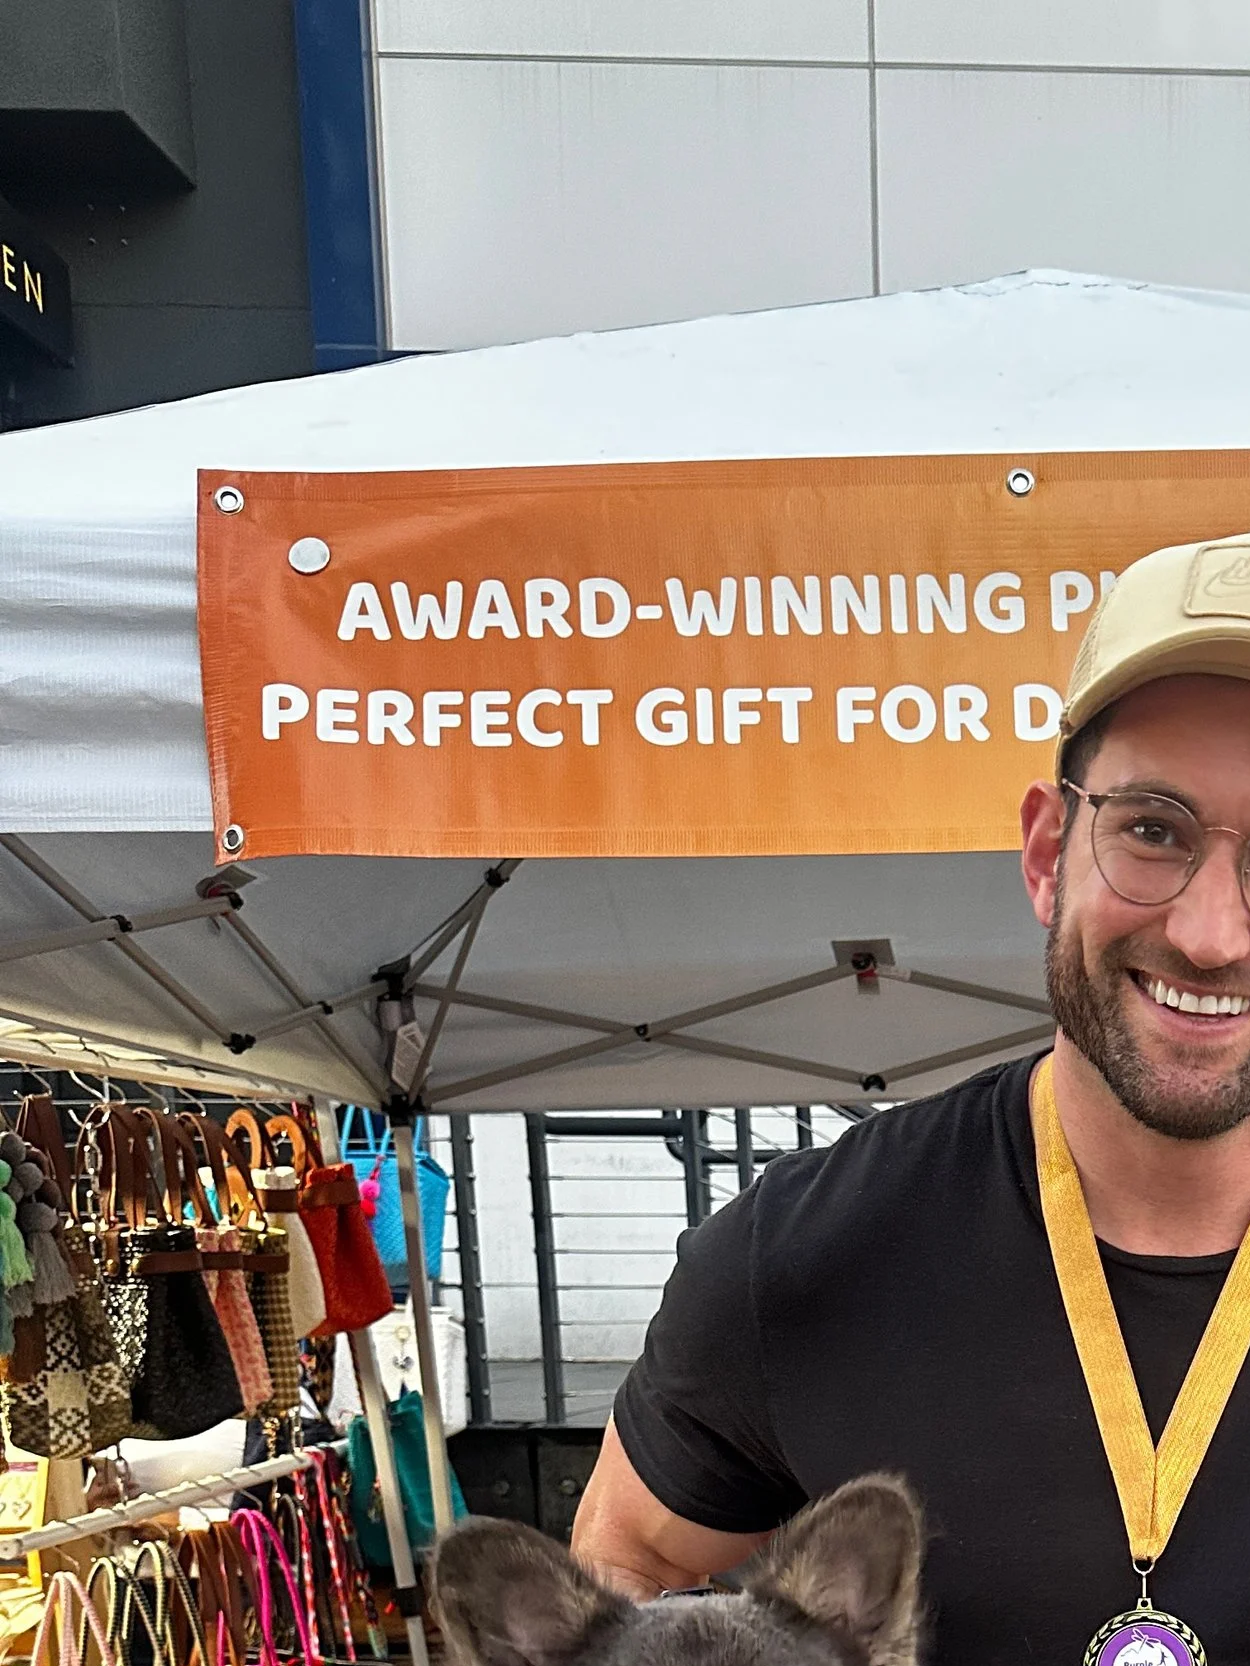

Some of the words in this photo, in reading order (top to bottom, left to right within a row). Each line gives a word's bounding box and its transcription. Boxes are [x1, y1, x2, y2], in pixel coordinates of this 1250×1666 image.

[337, 571, 1026, 641] AWARD-WINNING
[262, 684, 613, 747] PERFECT
[635, 687, 813, 746] GIFT
[836, 683, 991, 743] FOR
